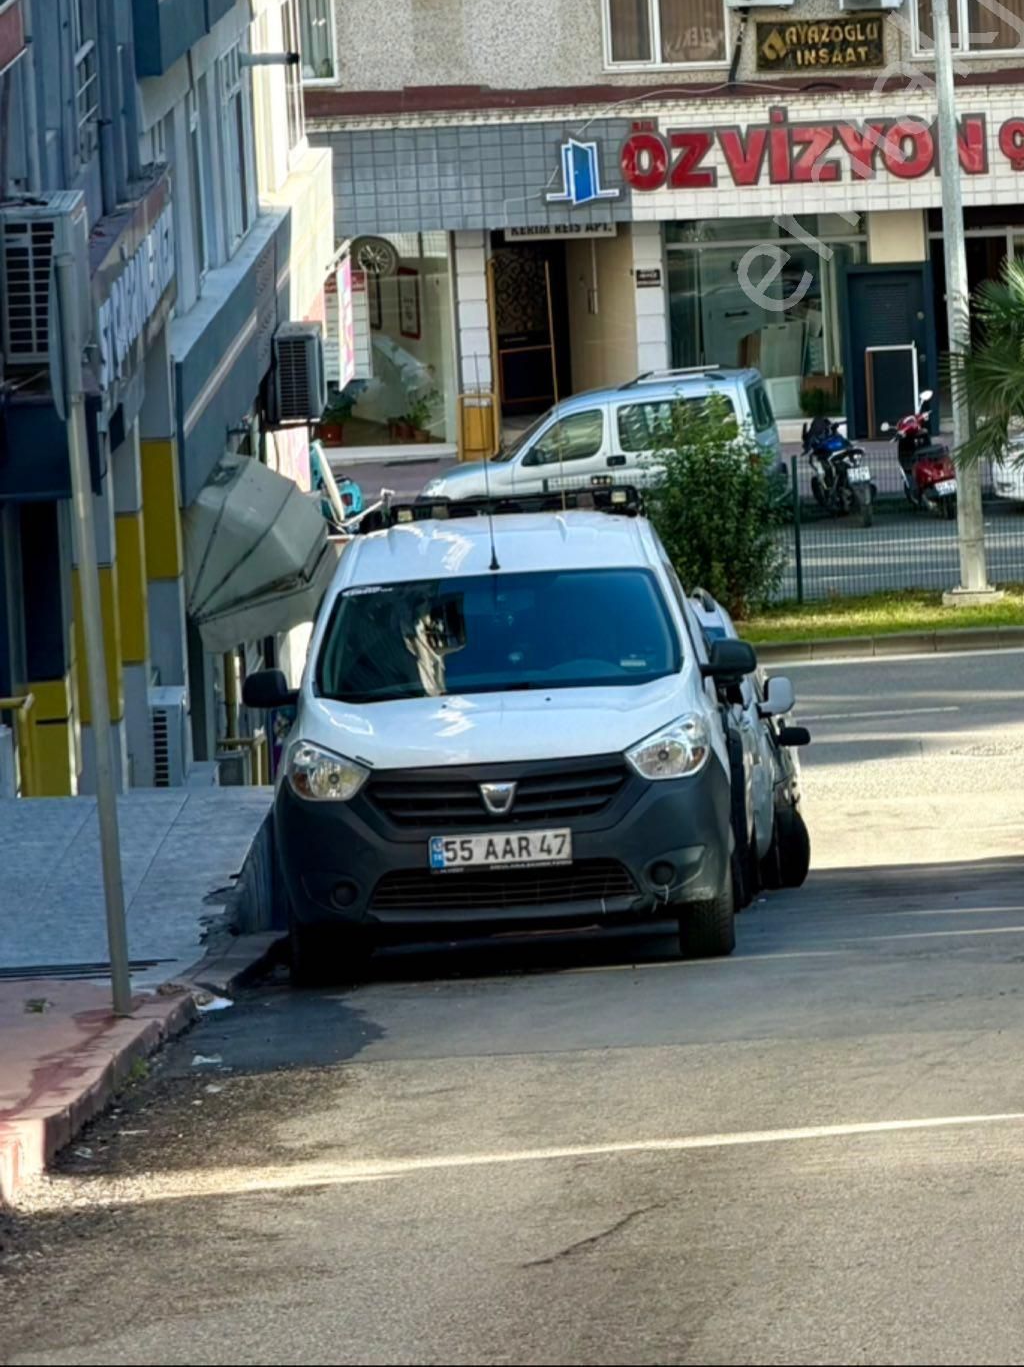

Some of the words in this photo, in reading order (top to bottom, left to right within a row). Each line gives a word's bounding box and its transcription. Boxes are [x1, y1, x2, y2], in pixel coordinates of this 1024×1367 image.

[443, 838, 474, 863] 55
[484, 835, 532, 861] AAR
[539, 834, 568, 857] 47
